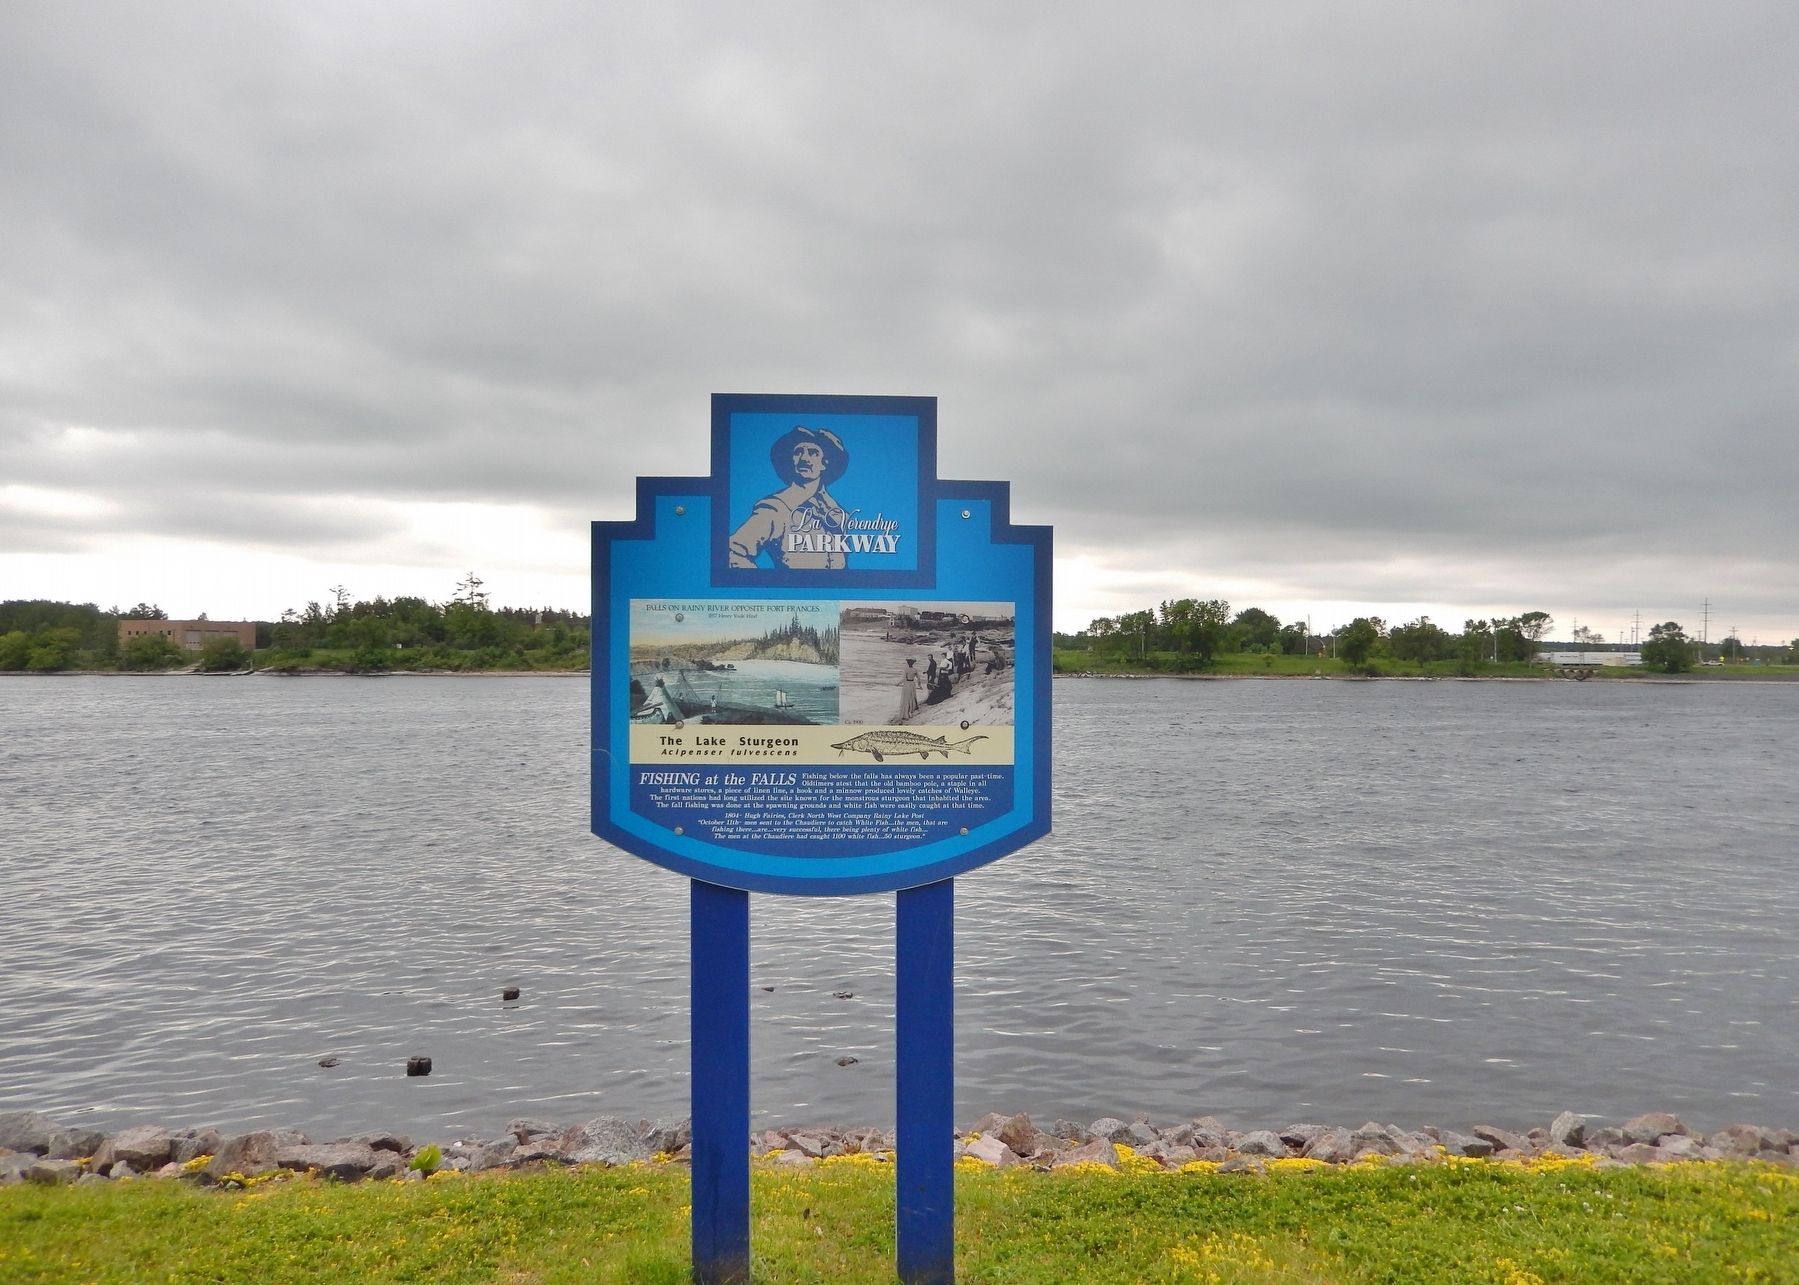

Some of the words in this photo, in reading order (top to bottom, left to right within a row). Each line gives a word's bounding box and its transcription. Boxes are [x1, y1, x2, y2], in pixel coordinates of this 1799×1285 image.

[791, 507, 821, 532] La
[787, 533, 900, 553] PARKWAY
[660, 736, 683, 745] The
[696, 736, 726, 745] Lake
[740, 736, 799, 748] Sturgeon
[661, 748, 723, 756] Acipenser
[639, 772, 700, 785] FISHING
[705, 774, 719, 785] at
[724, 773, 746, 785] the
[751, 772, 797, 785] FALLS
